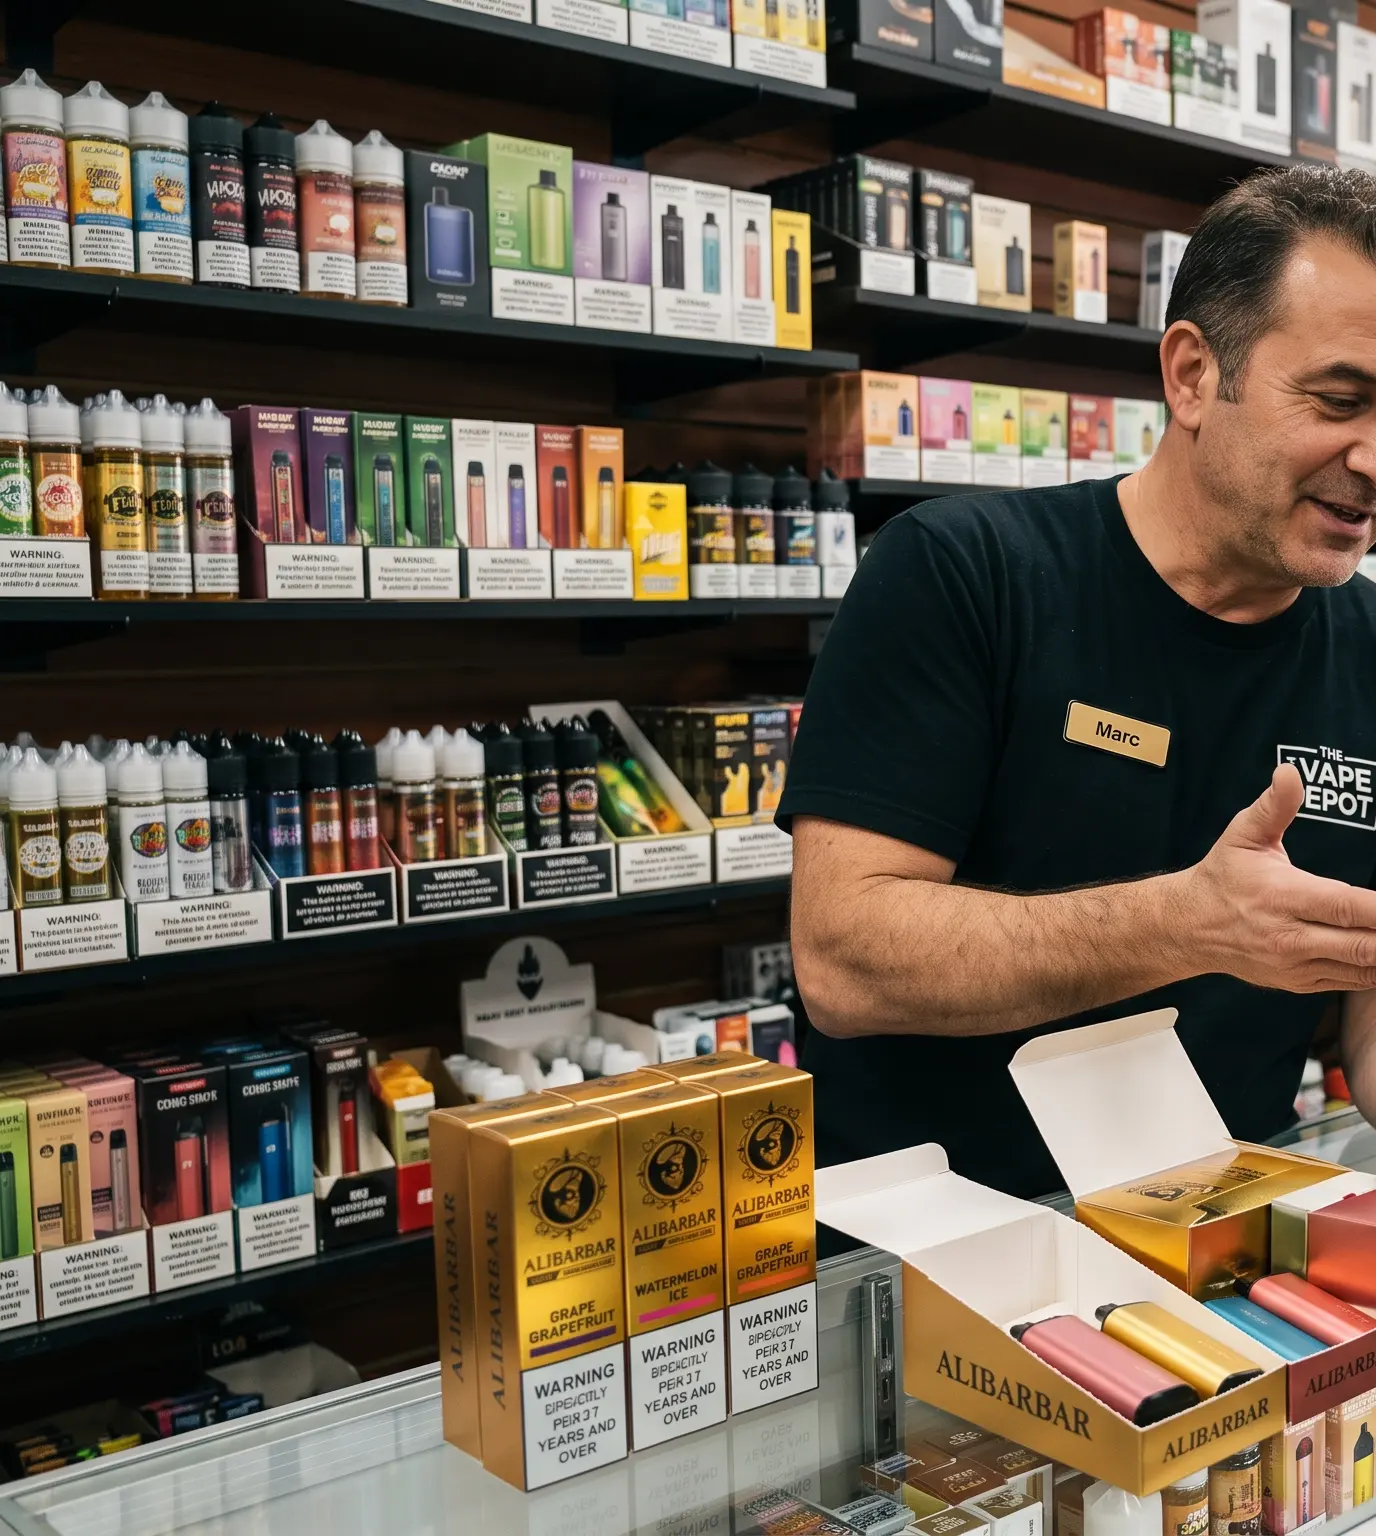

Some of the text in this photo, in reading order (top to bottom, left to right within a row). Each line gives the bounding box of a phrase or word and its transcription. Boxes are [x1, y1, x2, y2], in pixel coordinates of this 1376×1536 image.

[9, 549, 65, 560] WARNING:
[1095, 720, 1141, 748] Marc
[1319, 745, 1344, 762] THE
[1299, 757, 1373, 794] VAPE
[1304, 784, 1374, 819] EPOT
[731, 1183, 811, 1219] ALIBARBAR
[631, 1207, 717, 1244] ALIBARBAR
[523, 1237, 617, 1275] ALIBARBAR
[736, 1249, 810, 1281] GRAPEFRUIT
[755, 1240, 794, 1263] GRAPE
[443, 1191, 464, 1384] ALIBARBAR
[634, 1262, 719, 1298] WATERMELON
[669, 1286, 689, 1303] ICE
[484, 1209, 507, 1412] ALIBARBAR
[528, 1308, 616, 1344] GRAPEFRUIT
[549, 1299, 596, 1323] GRAPE
[739, 1298, 809, 1332] WARNING
[641, 1328, 716, 1364] WARNING
[534, 1362, 615, 1400] WARNING
[741, 1349, 809, 1380] YEARS AND
[759, 1370, 792, 1391] OVER
[644, 1381, 717, 1414] YEARS AND
[935, 1350, 1094, 1442] ALIBARBAR
[663, 1403, 698, 1425] OVER
[1161, 1396, 1270, 1464] ALIBARBAR
[537, 1417, 617, 1453] YEARS AND
[558, 1441, 598, 1464] OVER
